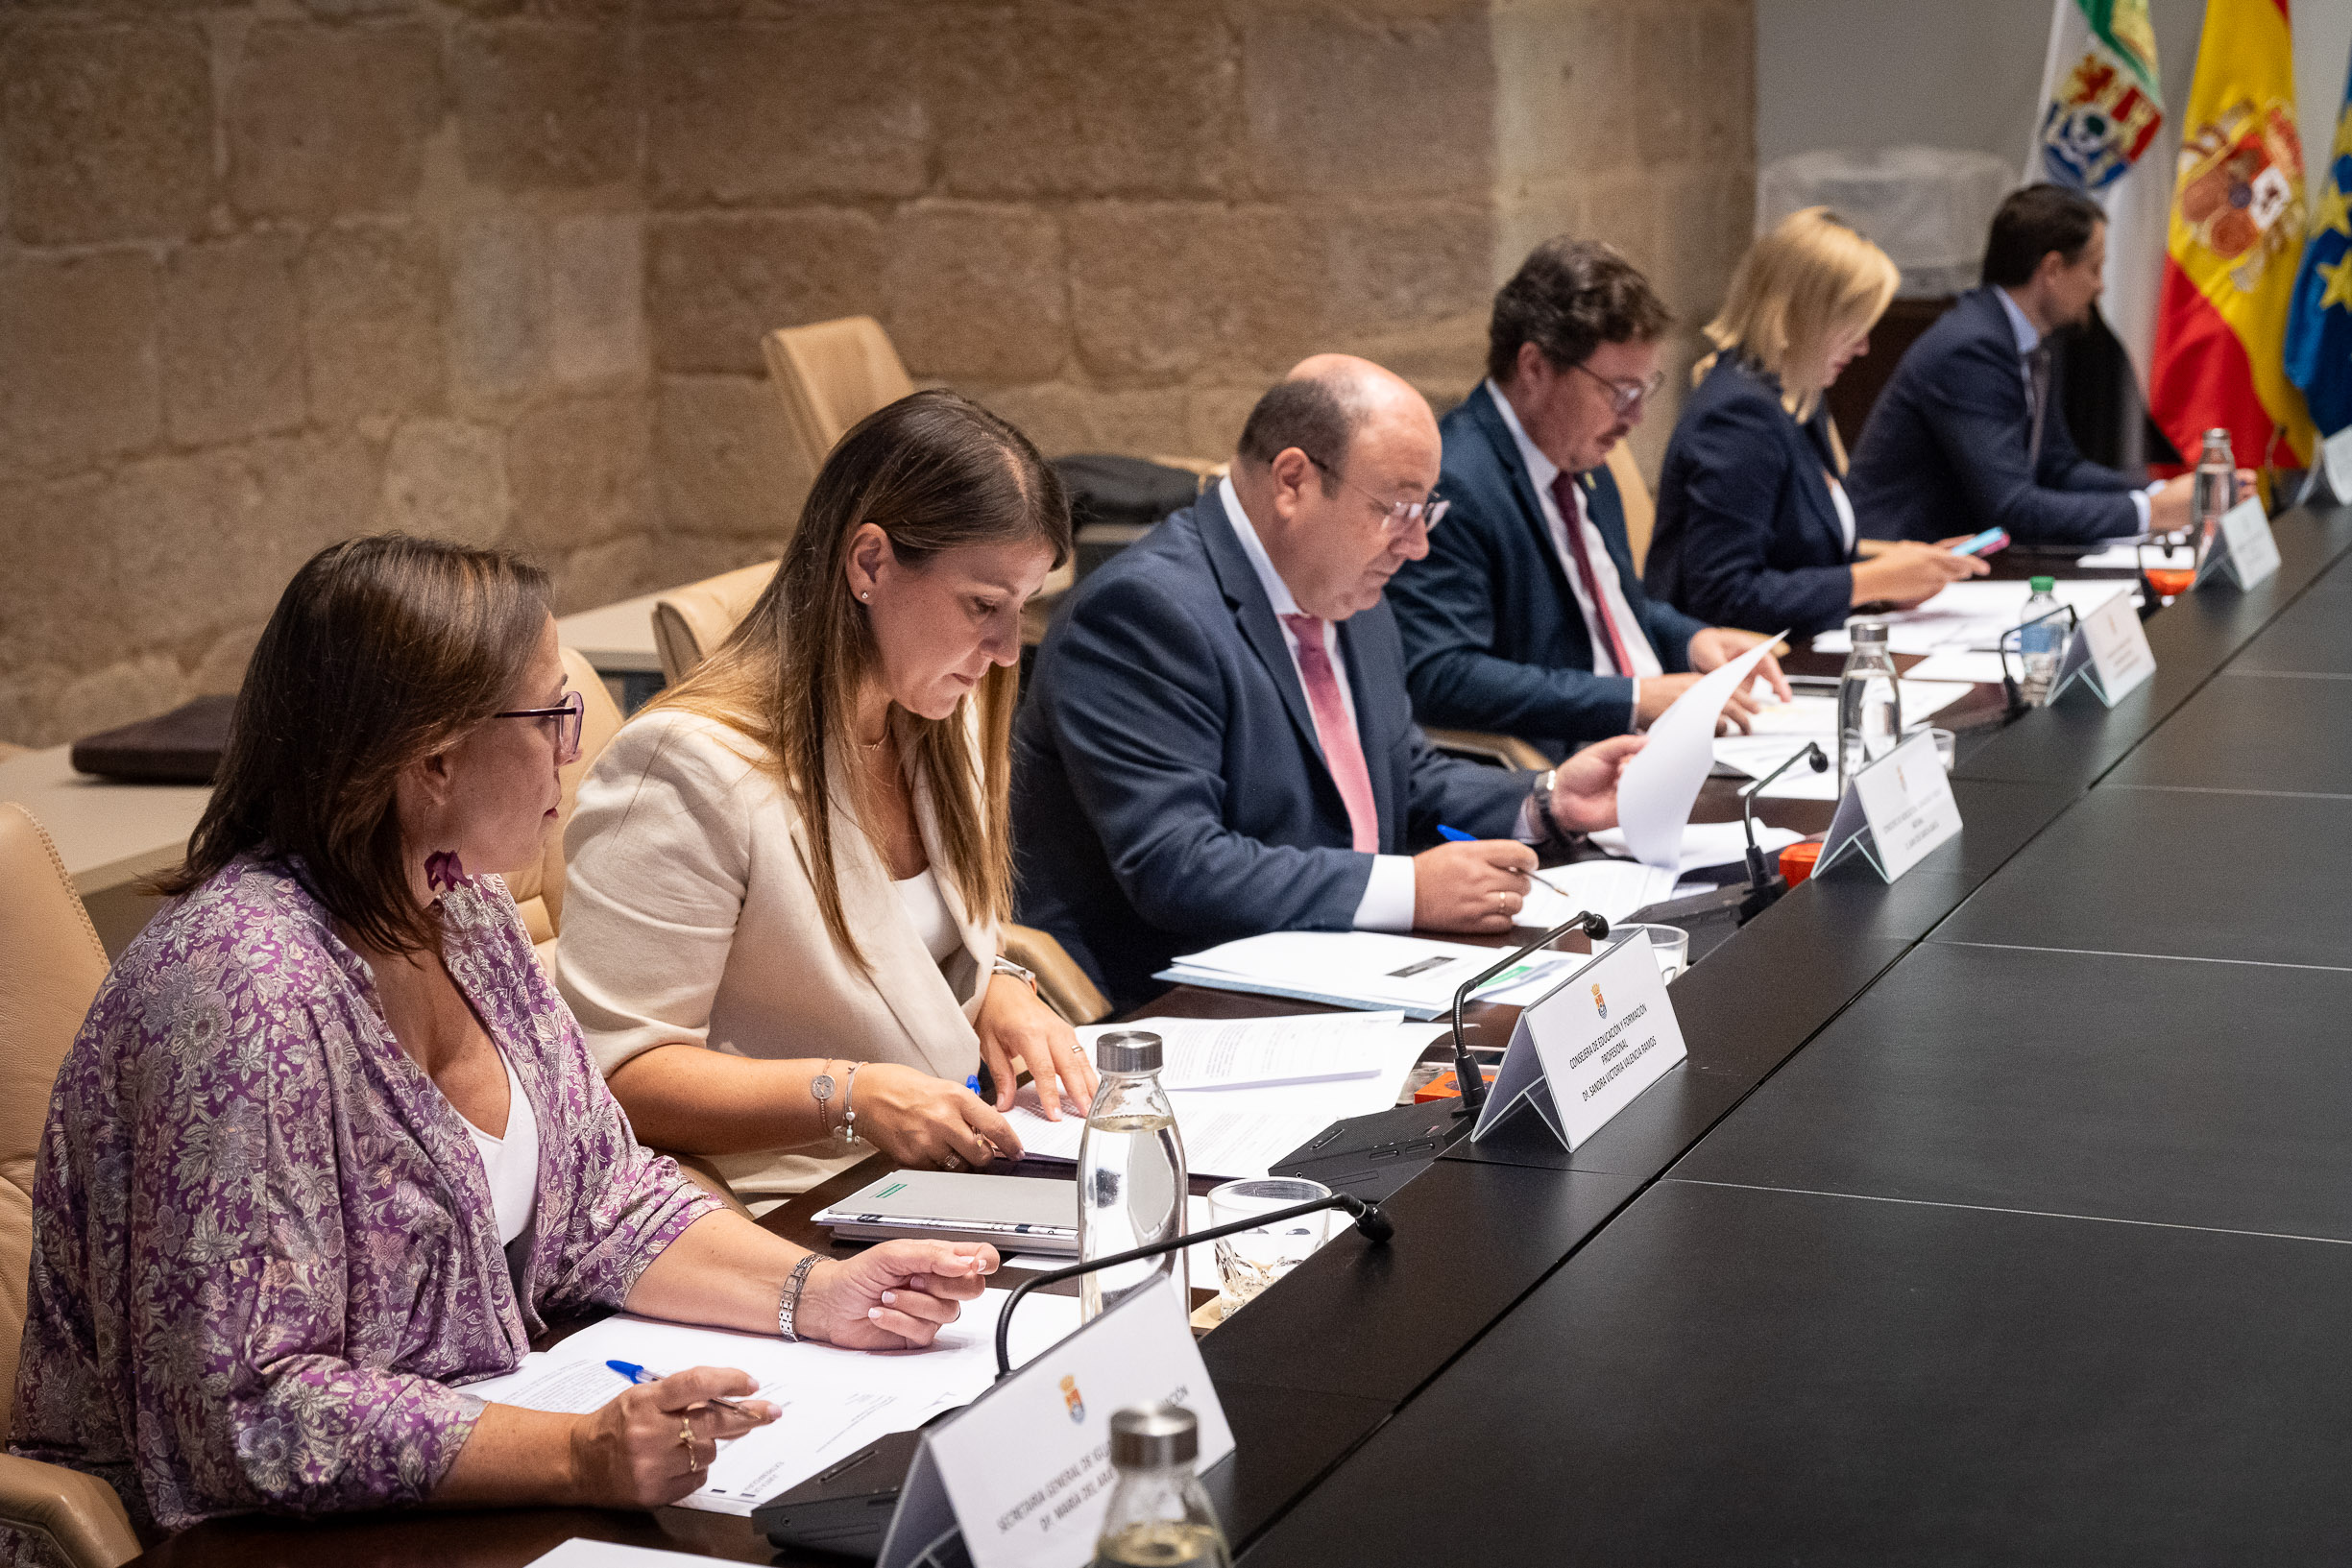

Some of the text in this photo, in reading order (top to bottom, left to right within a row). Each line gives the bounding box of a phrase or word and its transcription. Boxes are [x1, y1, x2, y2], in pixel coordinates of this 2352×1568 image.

[1569, 1045, 1593, 1070] CONSEJERA
[1591, 1040, 1600, 1052] DE
[1597, 1023, 1622, 1048] EDUCACIÓN
[1622, 1002, 1647, 1028] FORMACIÓN
[1588, 1076, 1608, 1097] SANDRA
[1605, 1062, 1625, 1083] VICTORIA
[1622, 1047, 1642, 1068] VALENCIA
[1640, 1035, 1657, 1054] RAMOS
[1600, 1039, 1629, 1065] PROFESIONAL
